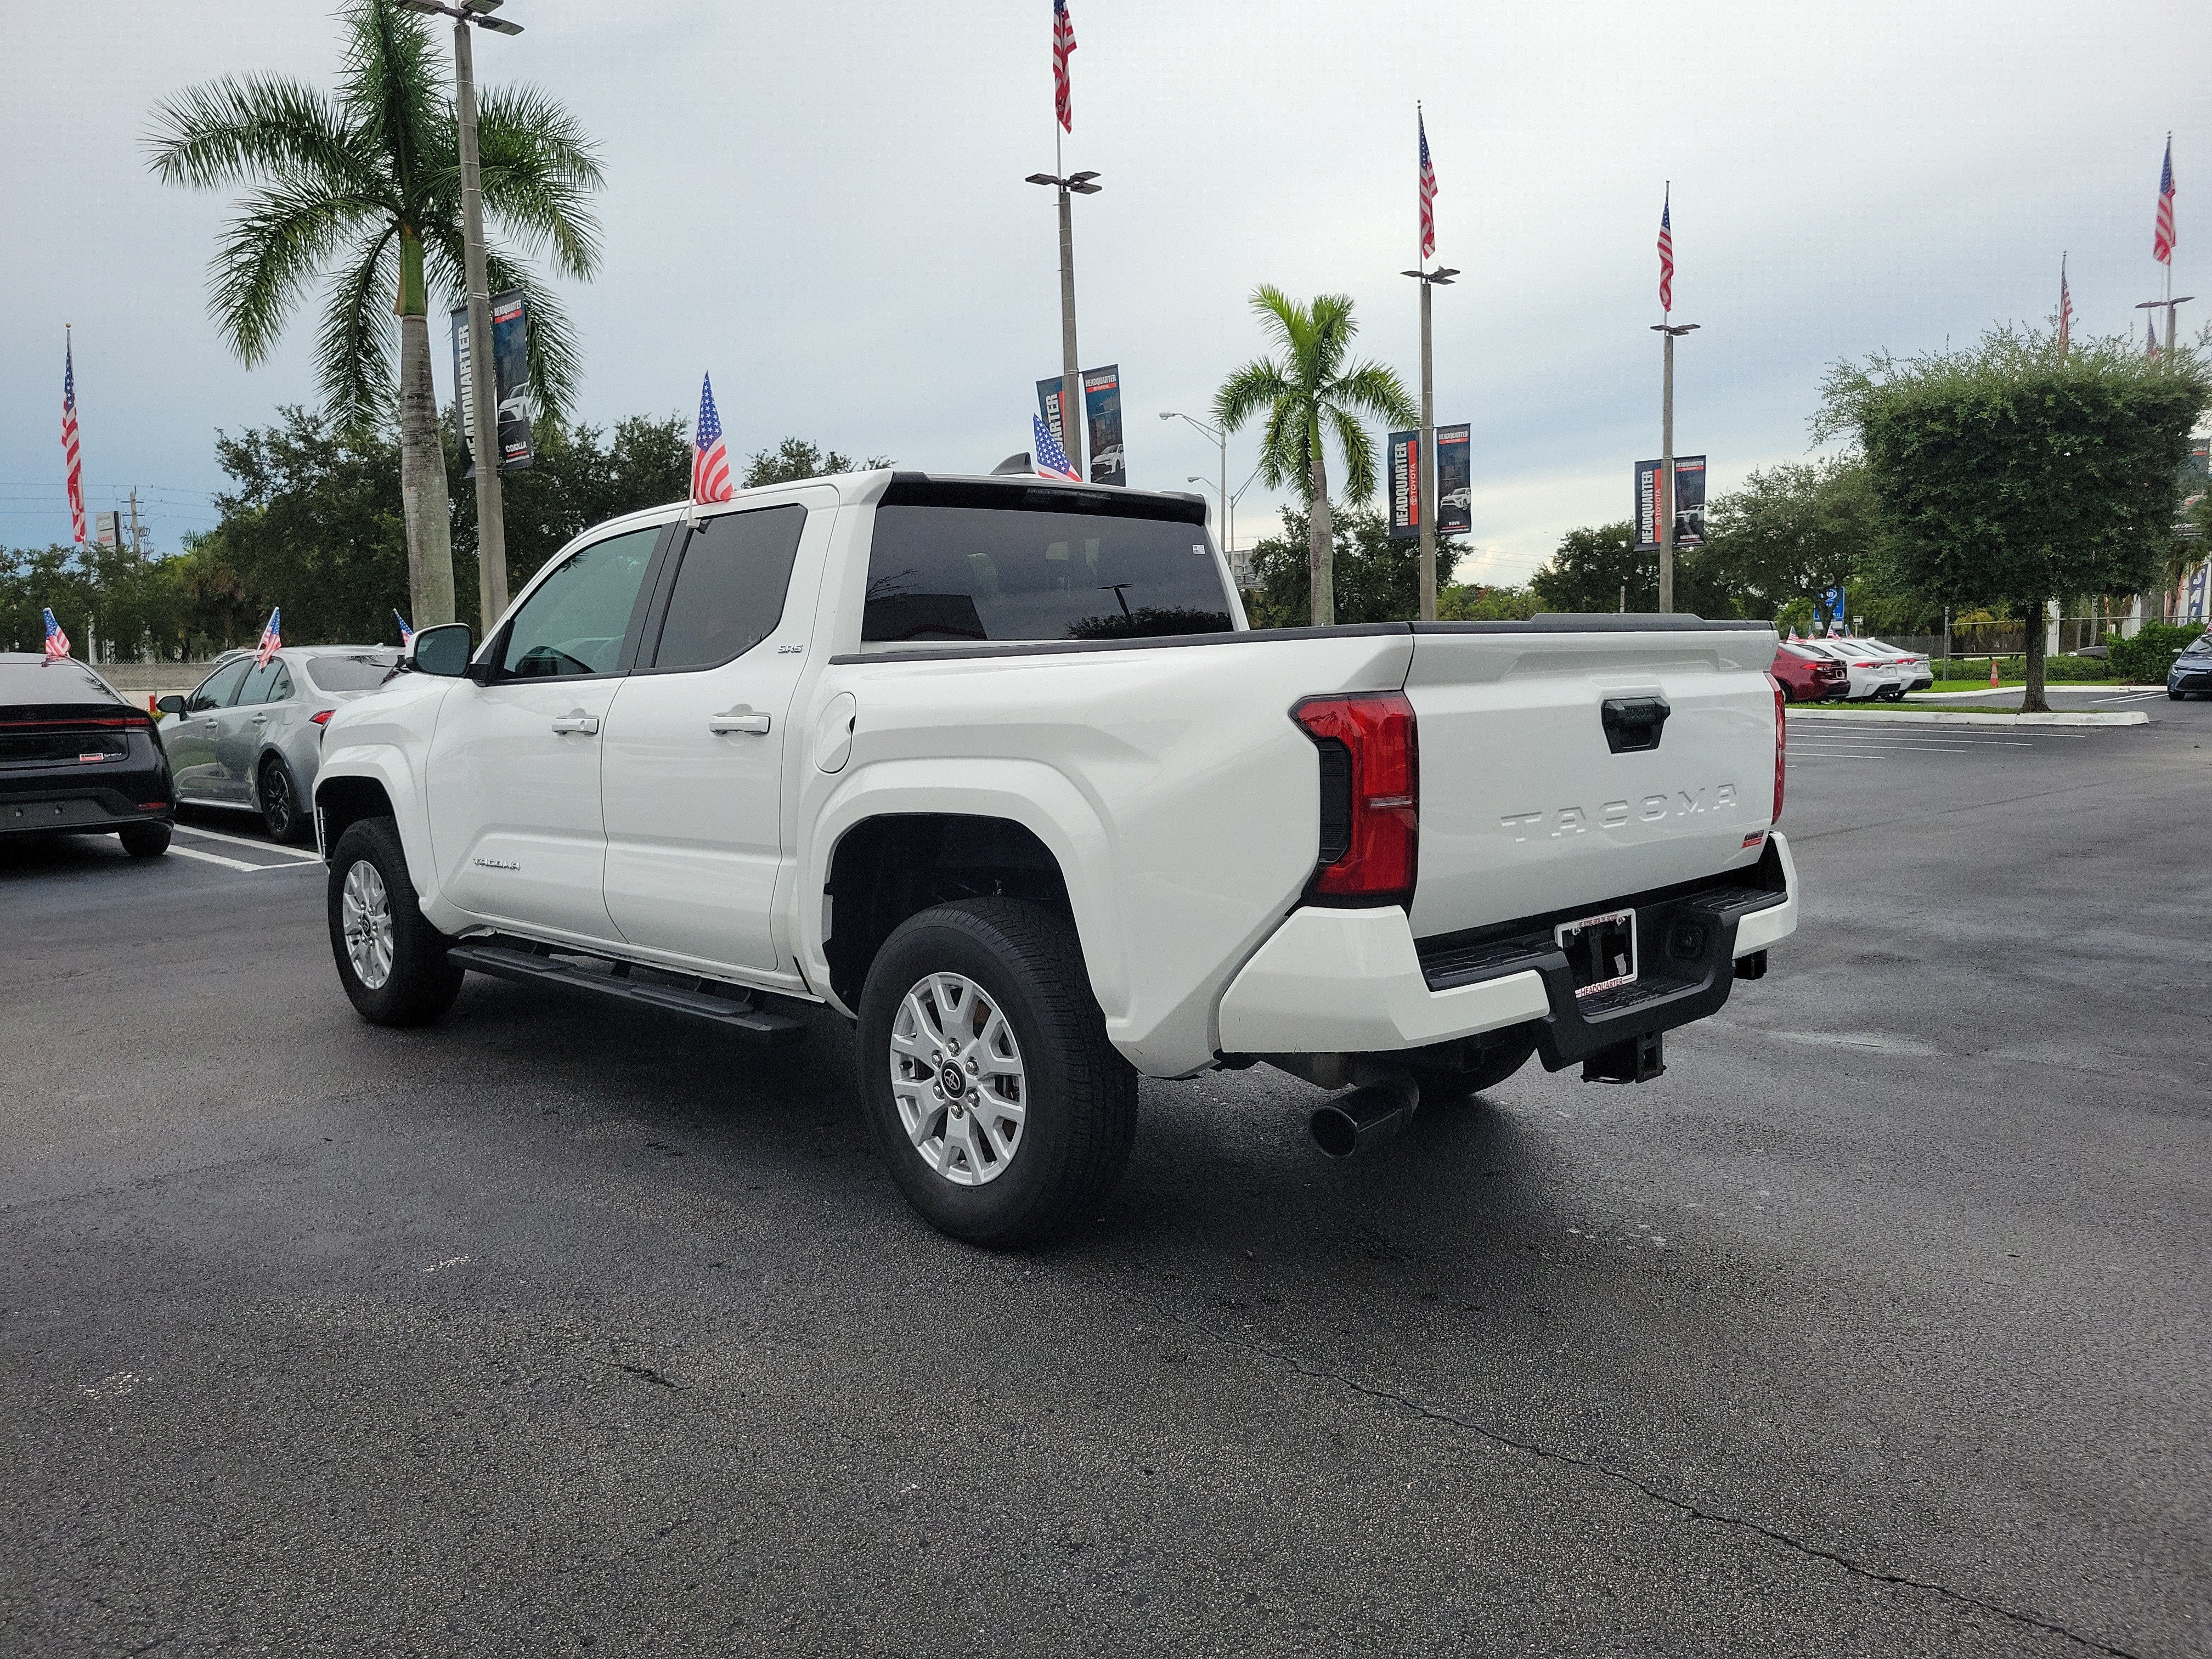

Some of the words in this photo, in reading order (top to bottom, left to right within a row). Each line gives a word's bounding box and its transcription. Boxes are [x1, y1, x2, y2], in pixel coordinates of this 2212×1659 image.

[1085, 374, 1116, 387] HEADQUARTER
[1395, 442, 1409, 527] HEADQUARTER
[1409, 463, 1418, 496] TOYOTA
[1641, 470, 1654, 544] HEADQUARTER
[777, 644, 804, 653] SR5
[1500, 783, 1737, 843] TACOMA
[473, 857, 521, 871] TACOMA
[1581, 978, 1623, 996] HEADQUARTER
